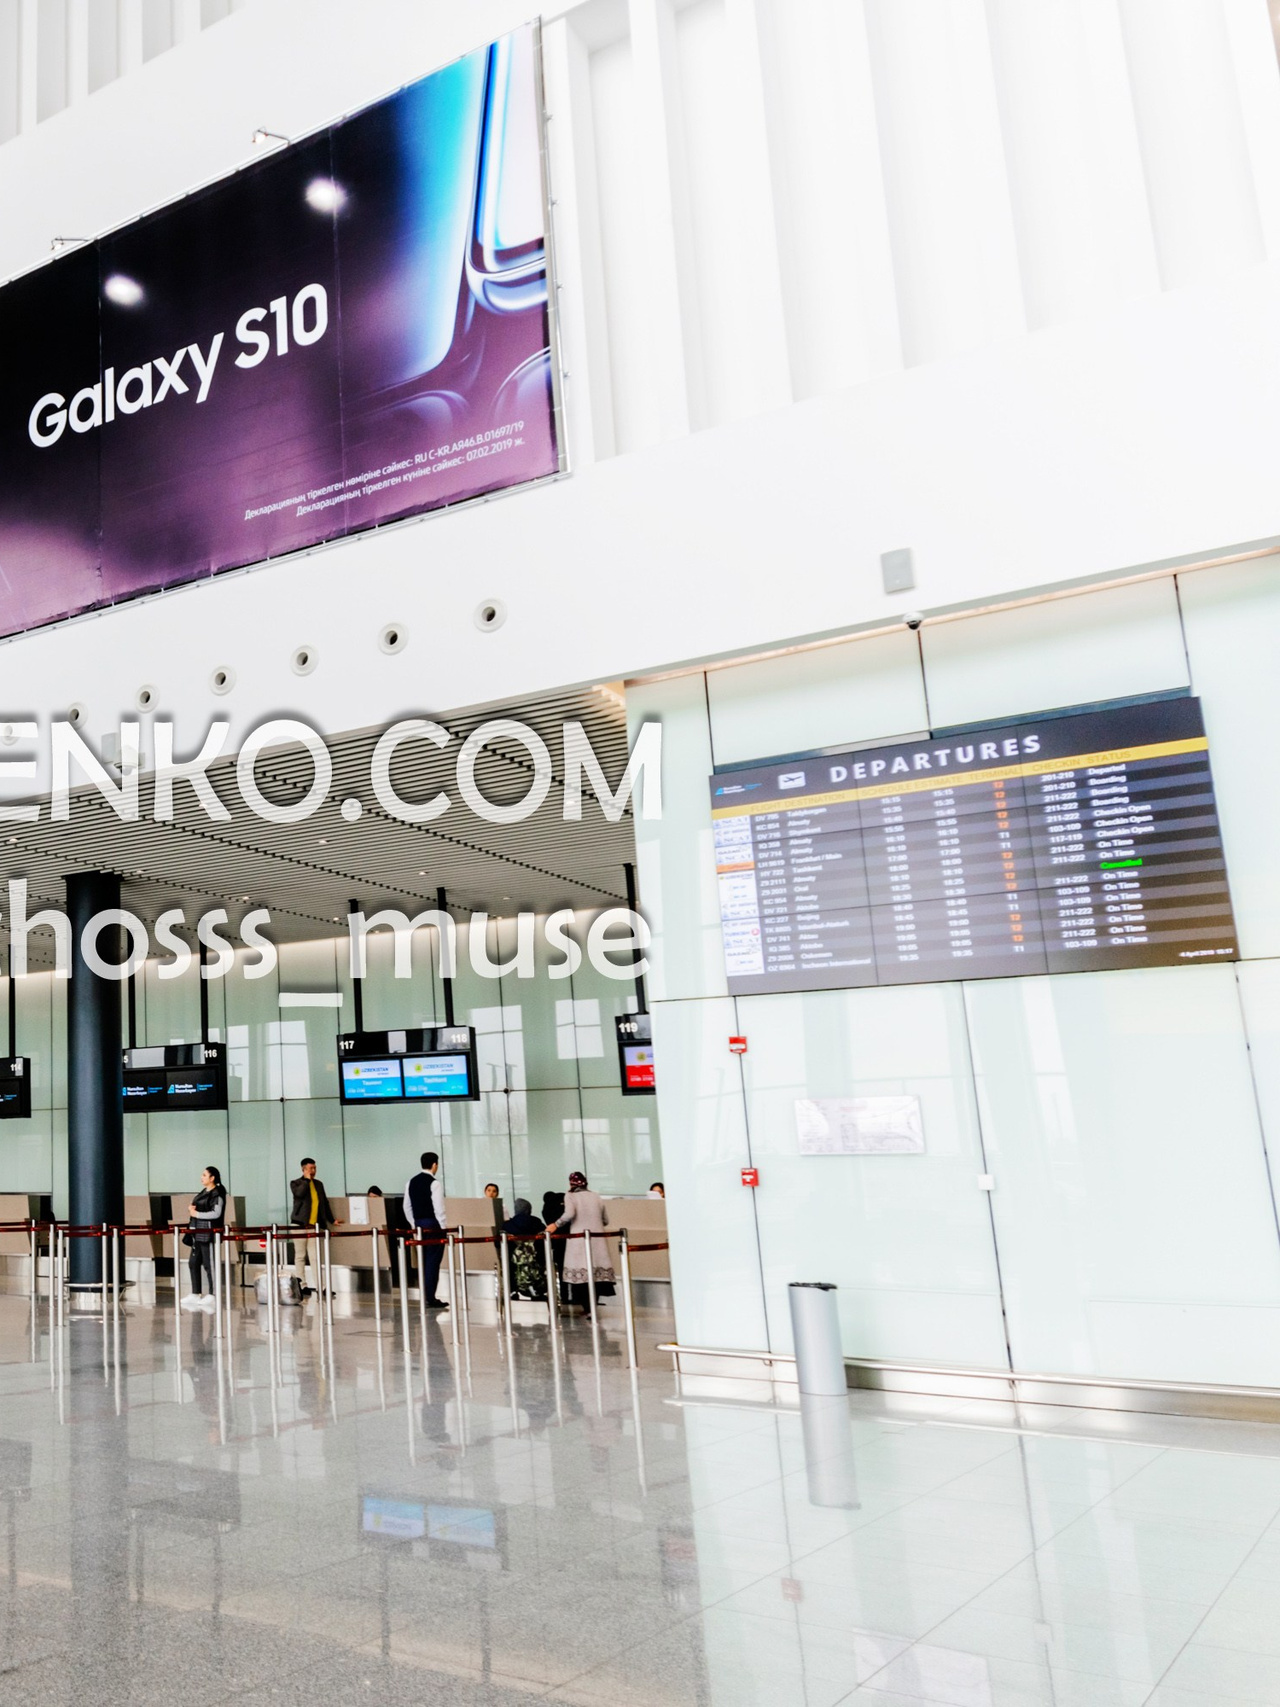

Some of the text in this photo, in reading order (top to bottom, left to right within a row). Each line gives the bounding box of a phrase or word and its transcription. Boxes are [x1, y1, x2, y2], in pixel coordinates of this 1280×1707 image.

[28, 283, 328, 447] Galaxy S10
[466, 438, 512, 461] 07.02.2019
[415, 452, 428, 464] RU
[829, 734, 1042, 783] DEPARTURES
[1085, 750, 1131, 764] STATUS
[1127, 803, 1152, 814] Open
[1129, 814, 1153, 825] Open
[1130, 824, 1155, 835] Open
[1097, 840, 1111, 848] On
[1112, 837, 1134, 846] Time
[1098, 851, 1113, 859] On
[1114, 848, 1135, 857] Time
[1101, 872, 1116, 880] On
[1117, 869, 1138, 878] Time
[1103, 883, 1117, 891] On
[1118, 880, 1140, 889] Time
[1104, 893, 1119, 901] On
[1120, 891, 1141, 900] Time
[1106, 904, 1120, 912] On
[1121, 902, 1143, 911] Time
[1107, 915, 1122, 923] On
[1123, 913, 1144, 921] Time
[1124, 924, 1146, 932] Time
[1110, 936, 1125, 944] On
[1126, 935, 1147, 943] Time
[619, 1022, 638, 1033] 119
[339, 1034, 467, 1049] 117 118
[204, 1049, 217, 1058] 116
